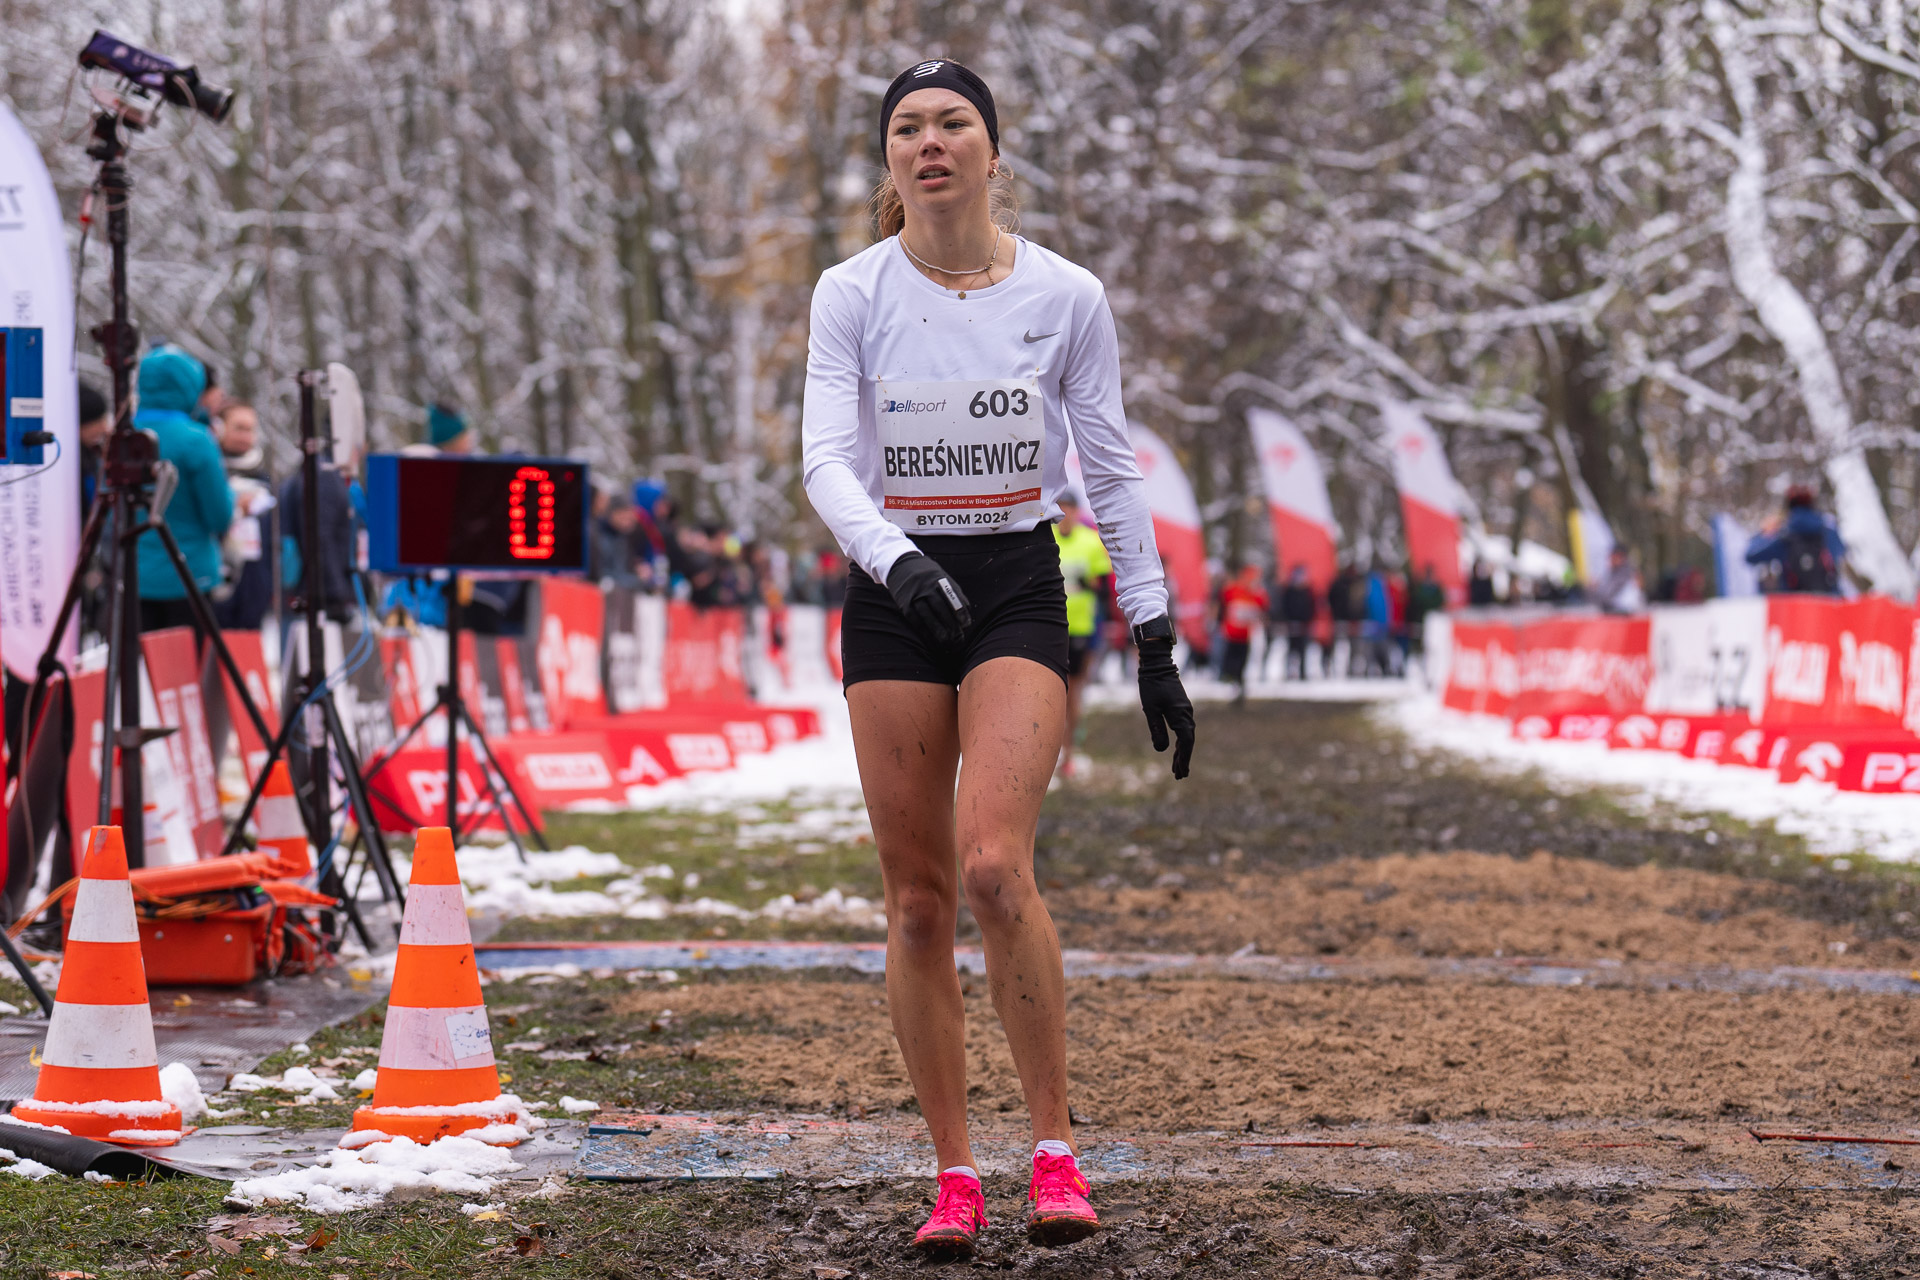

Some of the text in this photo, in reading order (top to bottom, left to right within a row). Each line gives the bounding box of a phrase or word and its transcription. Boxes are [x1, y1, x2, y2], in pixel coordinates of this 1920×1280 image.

[886, 399, 947, 415] Bellsport
[969, 389, 1029, 418] 603
[884, 438, 1040, 477] BEREŚNIEWICZ
[975, 497, 1003, 506] Biegach
[917, 511, 1010, 526] BYTOM 2024
